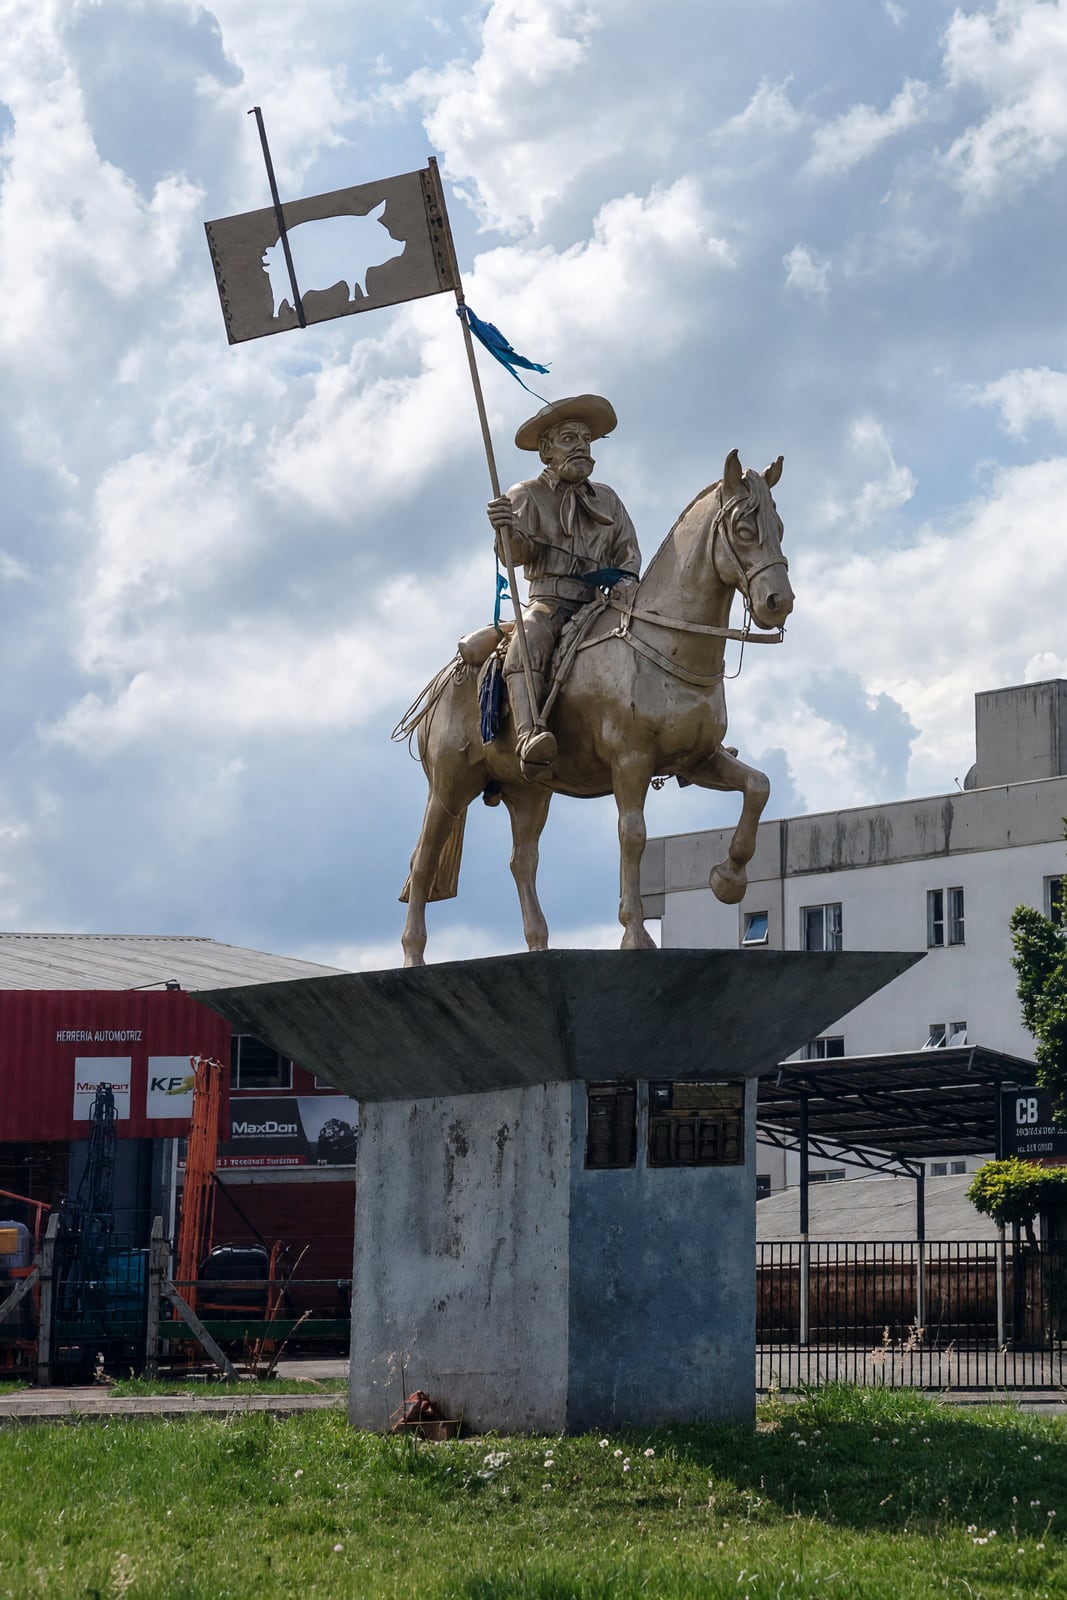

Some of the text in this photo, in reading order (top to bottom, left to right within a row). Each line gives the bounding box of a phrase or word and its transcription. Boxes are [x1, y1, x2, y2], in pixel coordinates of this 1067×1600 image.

[94, 1030, 142, 1042] AUTOMOTRIZ
[76, 1082, 129, 1091] Maon
[1016, 1098, 1038, 1124] CB
[231, 1121, 298, 1134] MaxDon
